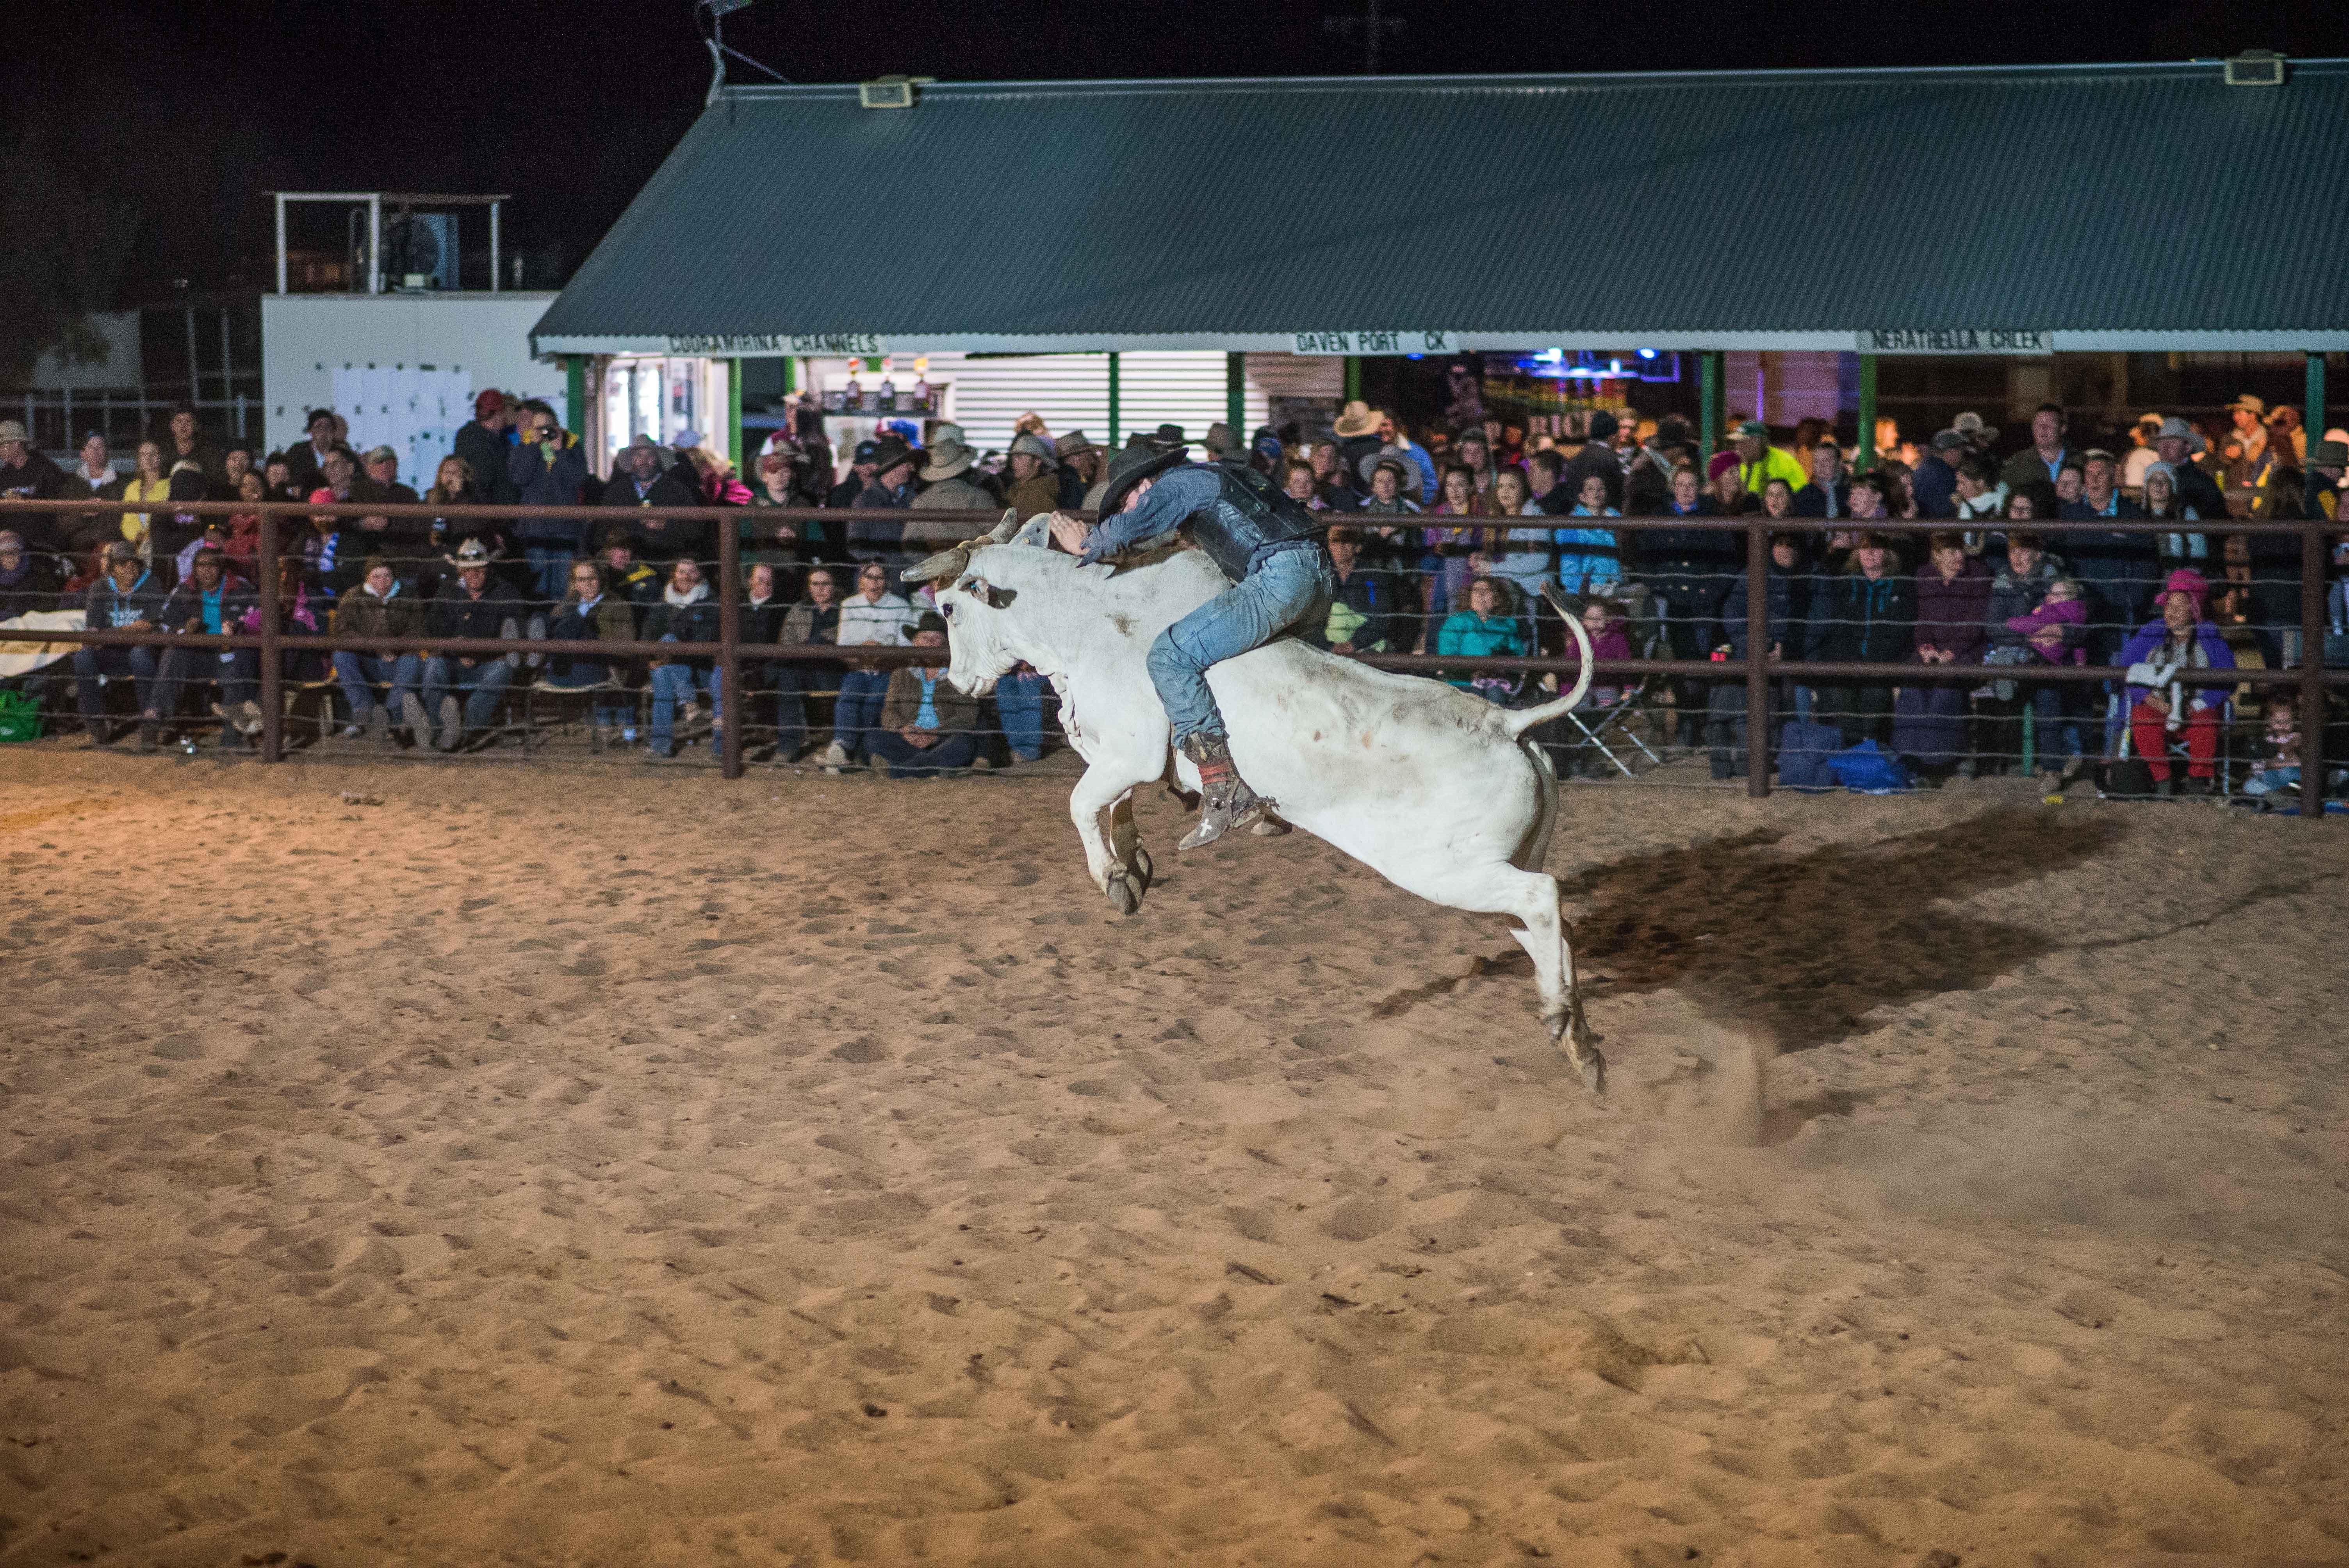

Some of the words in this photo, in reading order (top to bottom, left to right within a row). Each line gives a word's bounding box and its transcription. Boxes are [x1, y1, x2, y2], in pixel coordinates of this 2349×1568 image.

[791, 333, 879, 353] CHANNELS
[1296, 333, 1349, 352] DAVEN
[1358, 332, 1399, 351] PORT
[1992, 330, 2043, 350] CREEK
